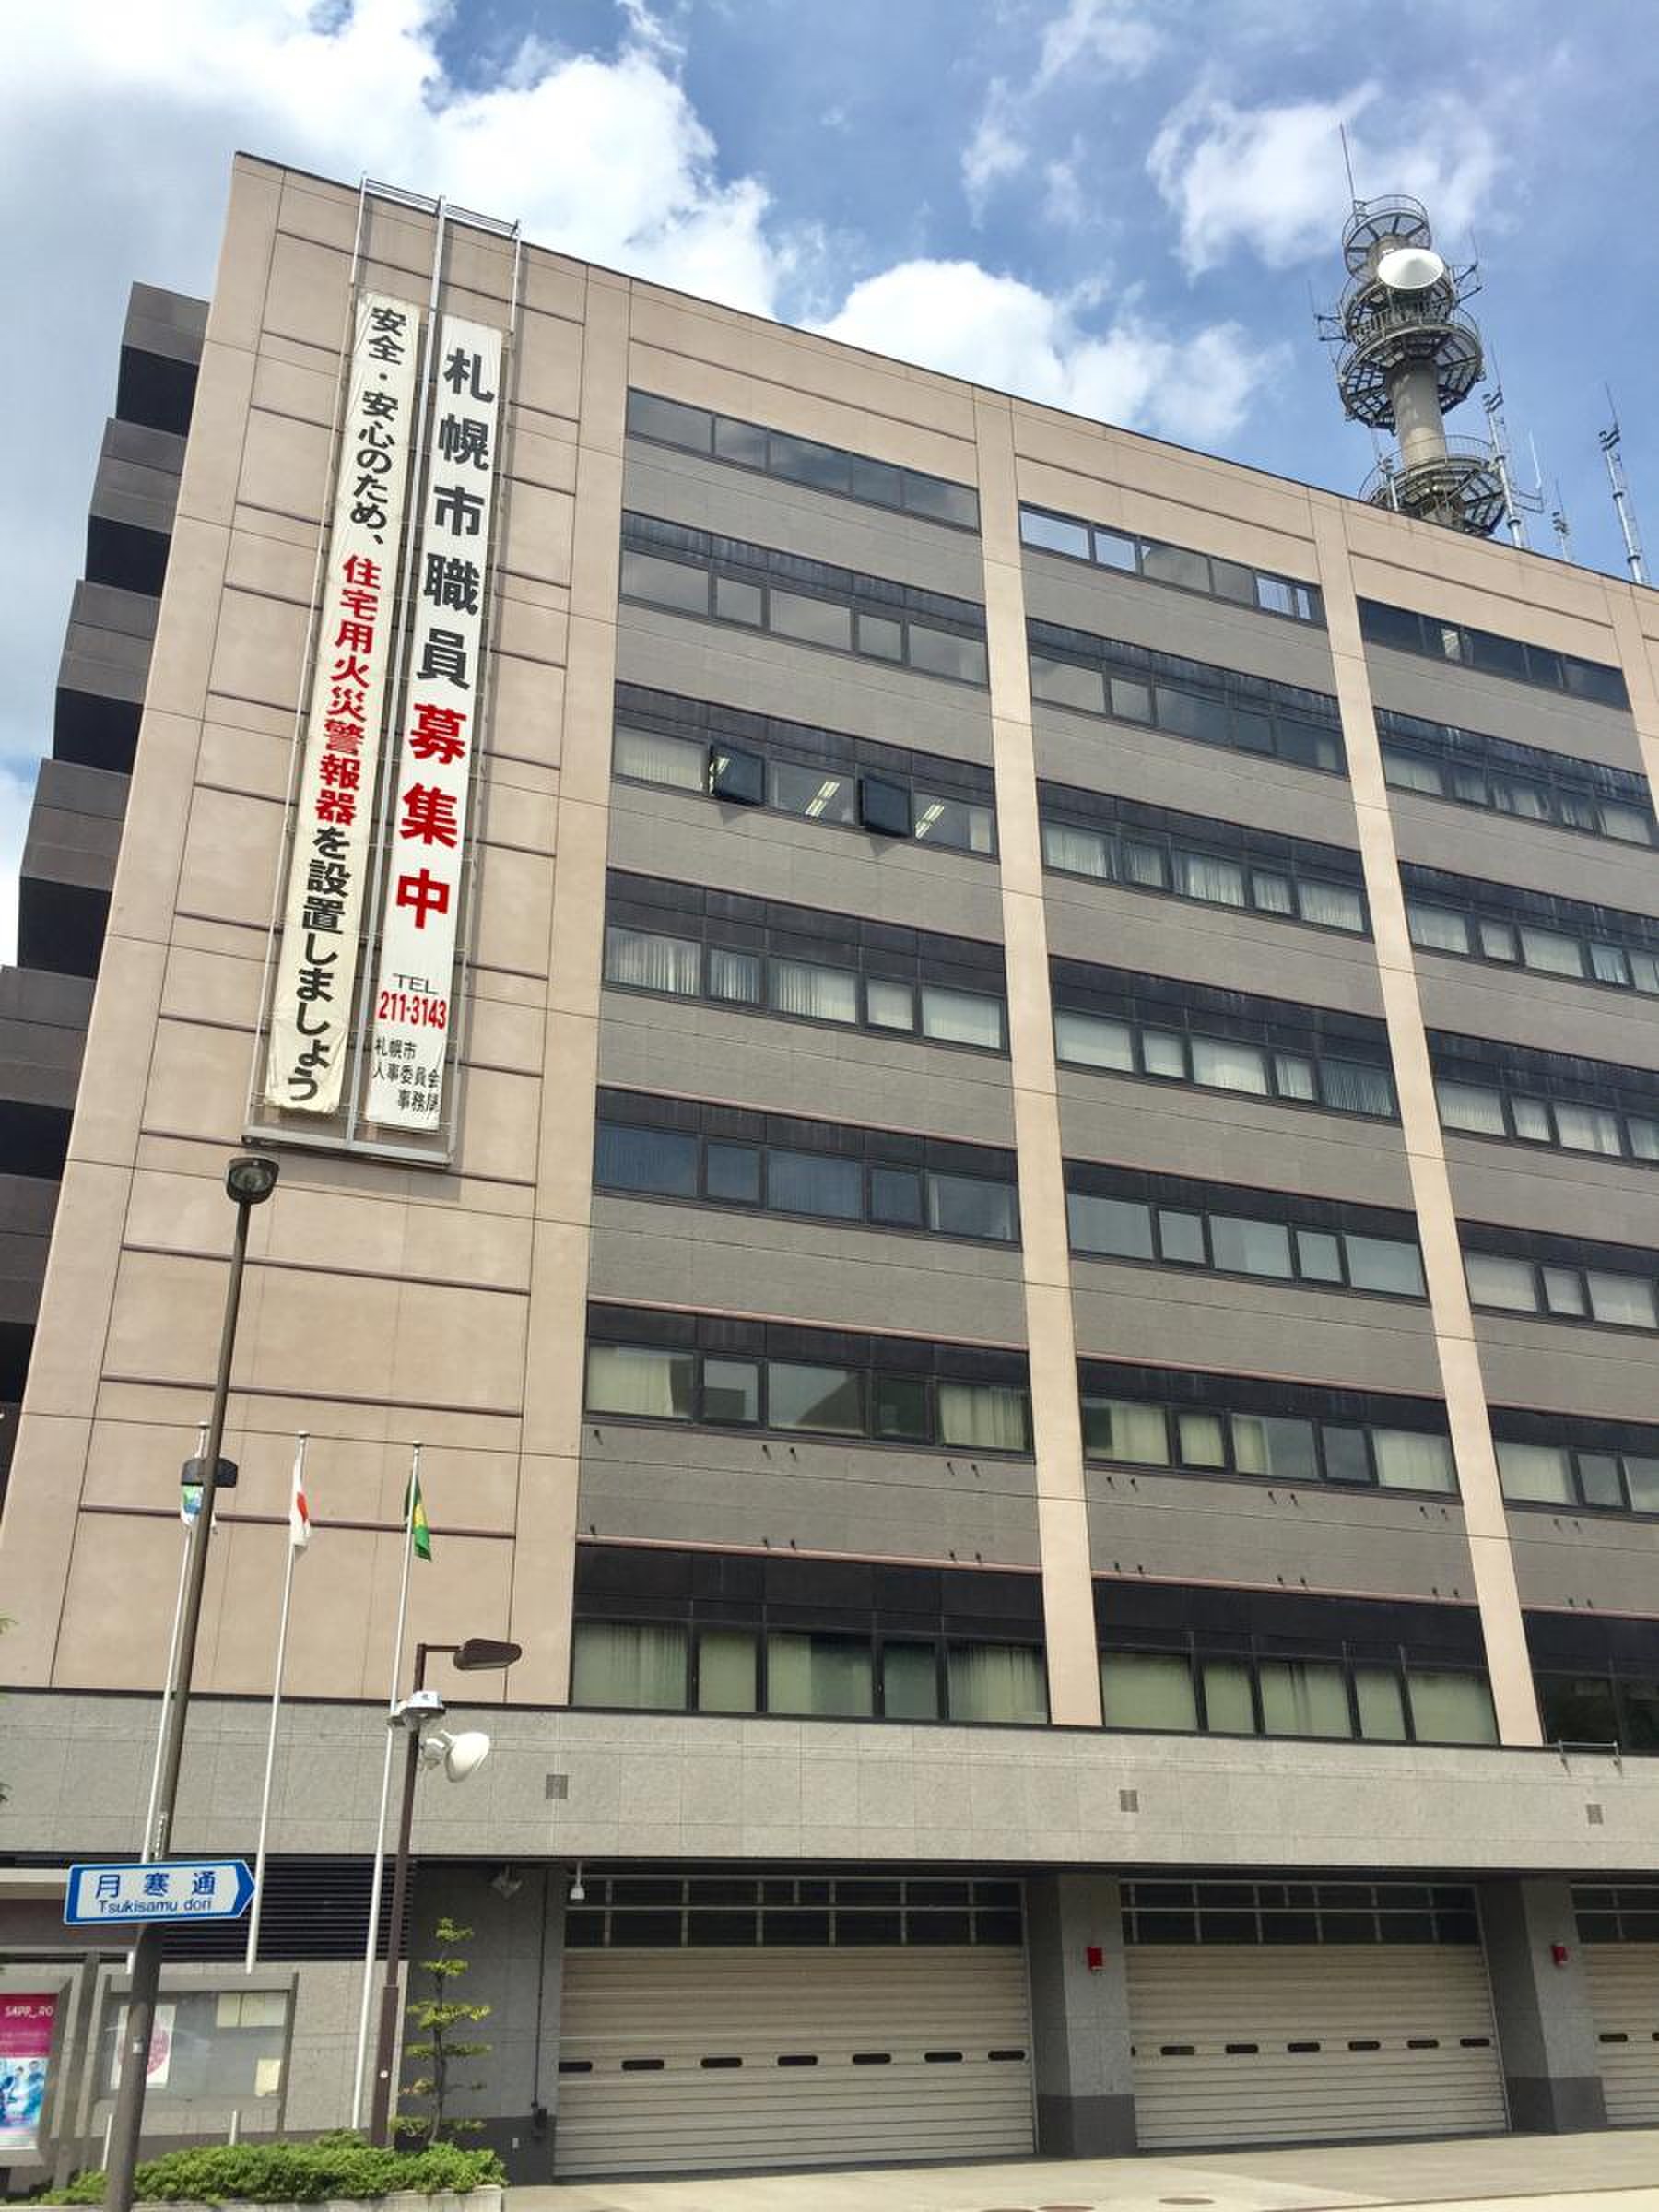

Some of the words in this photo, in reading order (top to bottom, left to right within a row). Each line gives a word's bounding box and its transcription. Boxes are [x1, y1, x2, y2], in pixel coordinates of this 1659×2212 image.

[396, 348, 494, 930] 札幌市職員募集中
[392, 972, 440, 994] TEL
[374, 1036, 418, 1060] 札幌市
[372, 1062, 441, 1088] 人事委員会
[95, 1871, 216, 1899] 月寒通
[98, 1900, 178, 1914] Tsukisamu
[183, 1898, 212, 1912] dori
